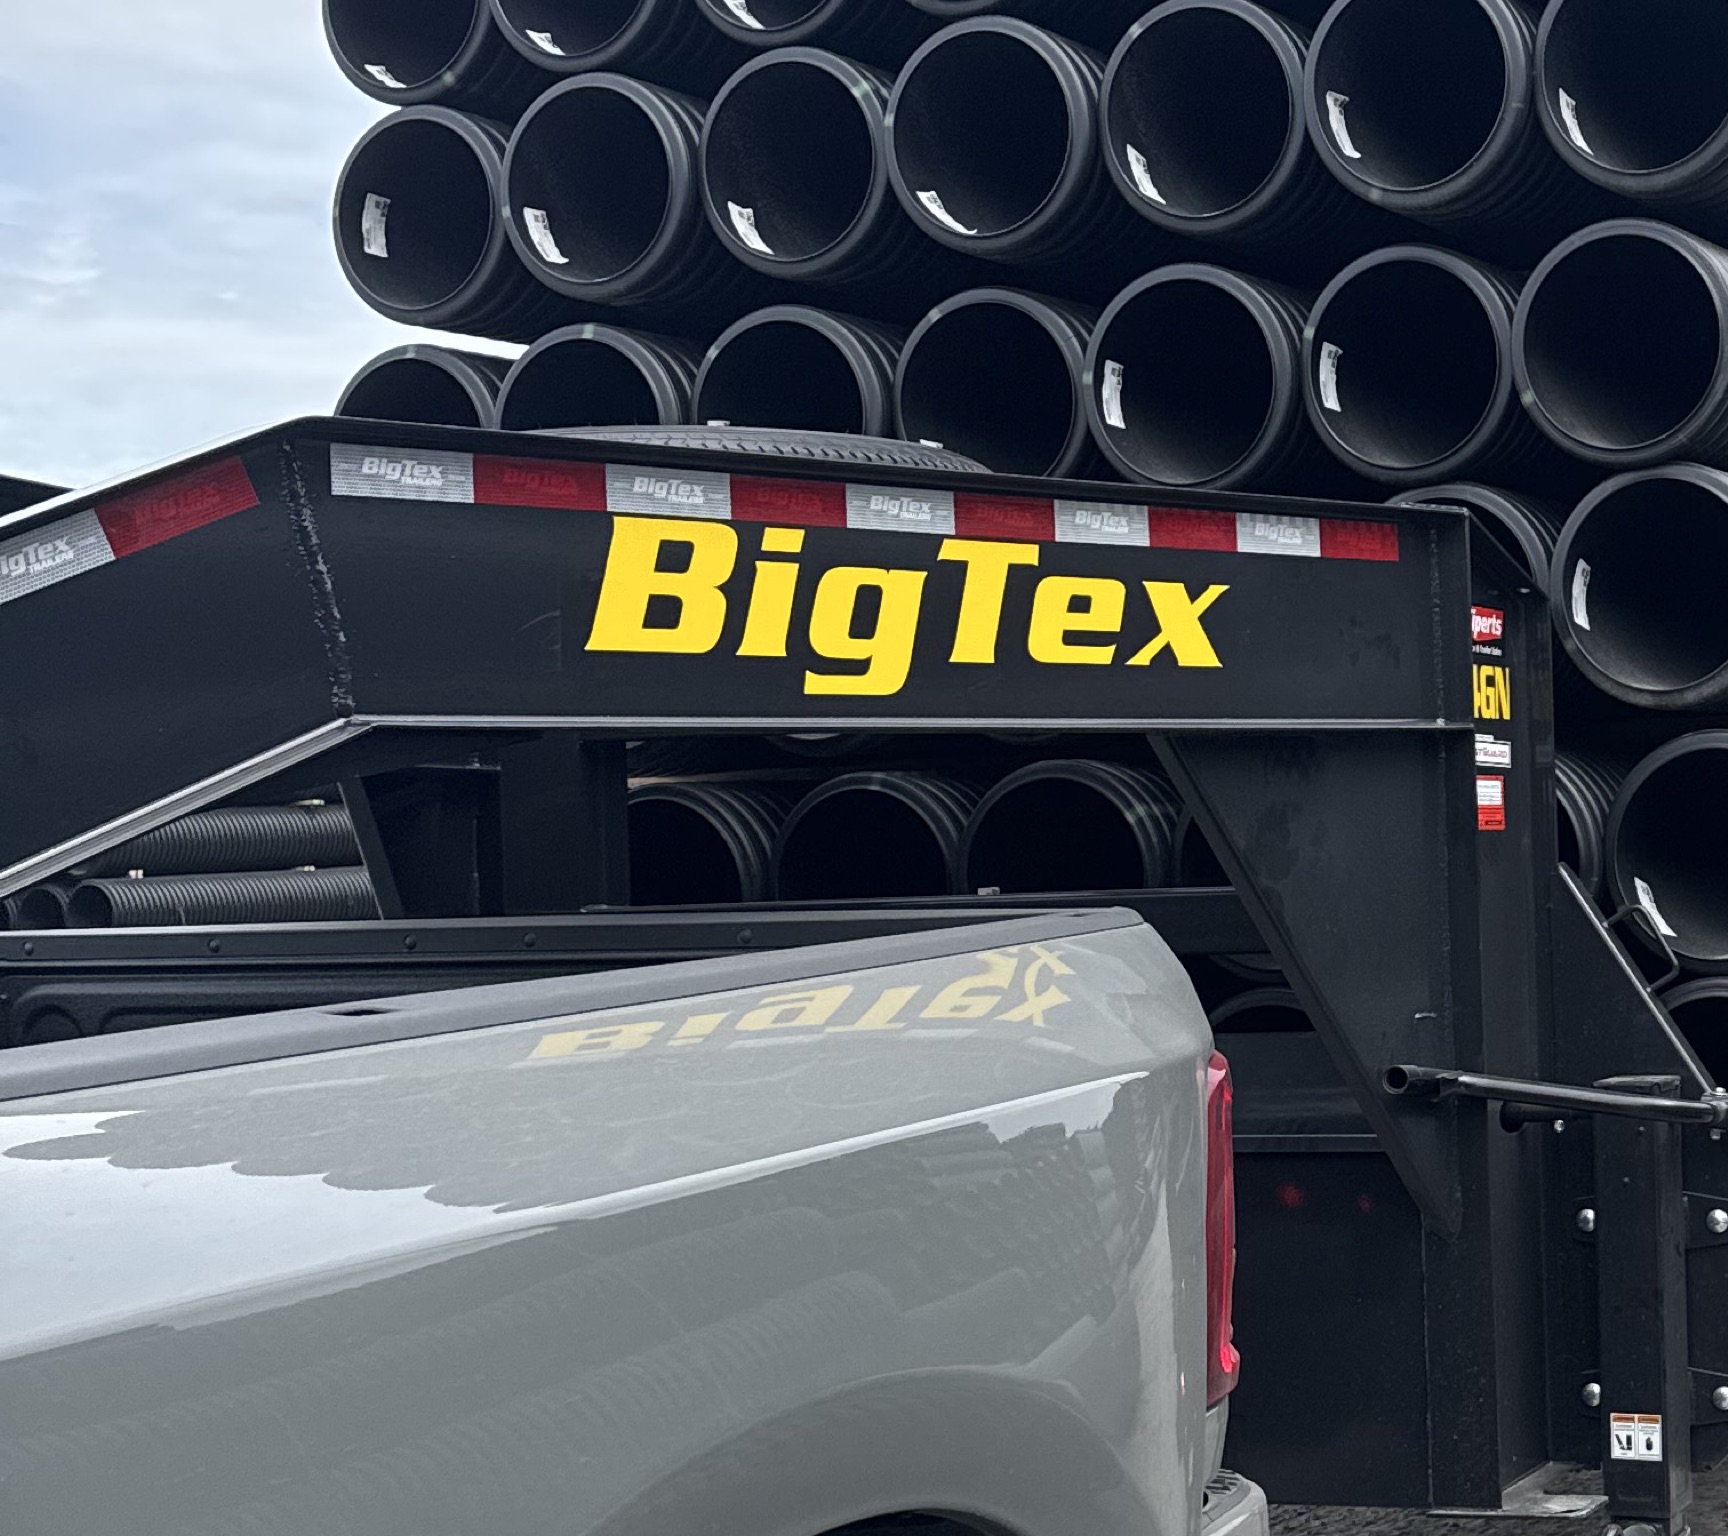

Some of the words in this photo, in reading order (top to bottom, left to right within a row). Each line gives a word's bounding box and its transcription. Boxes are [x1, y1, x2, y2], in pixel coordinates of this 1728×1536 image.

[362, 456, 443, 481] BigTex
[633, 476, 704, 498] BigTex
[870, 495, 931, 514] BigTex
[1074, 510, 1129, 529] BigTex
[1254, 523, 1303, 539] BigTex
[0, 536, 69, 578] igTex
[29, 549, 74, 574] TRAILERS
[584, 515, 1231, 695] BigTex
